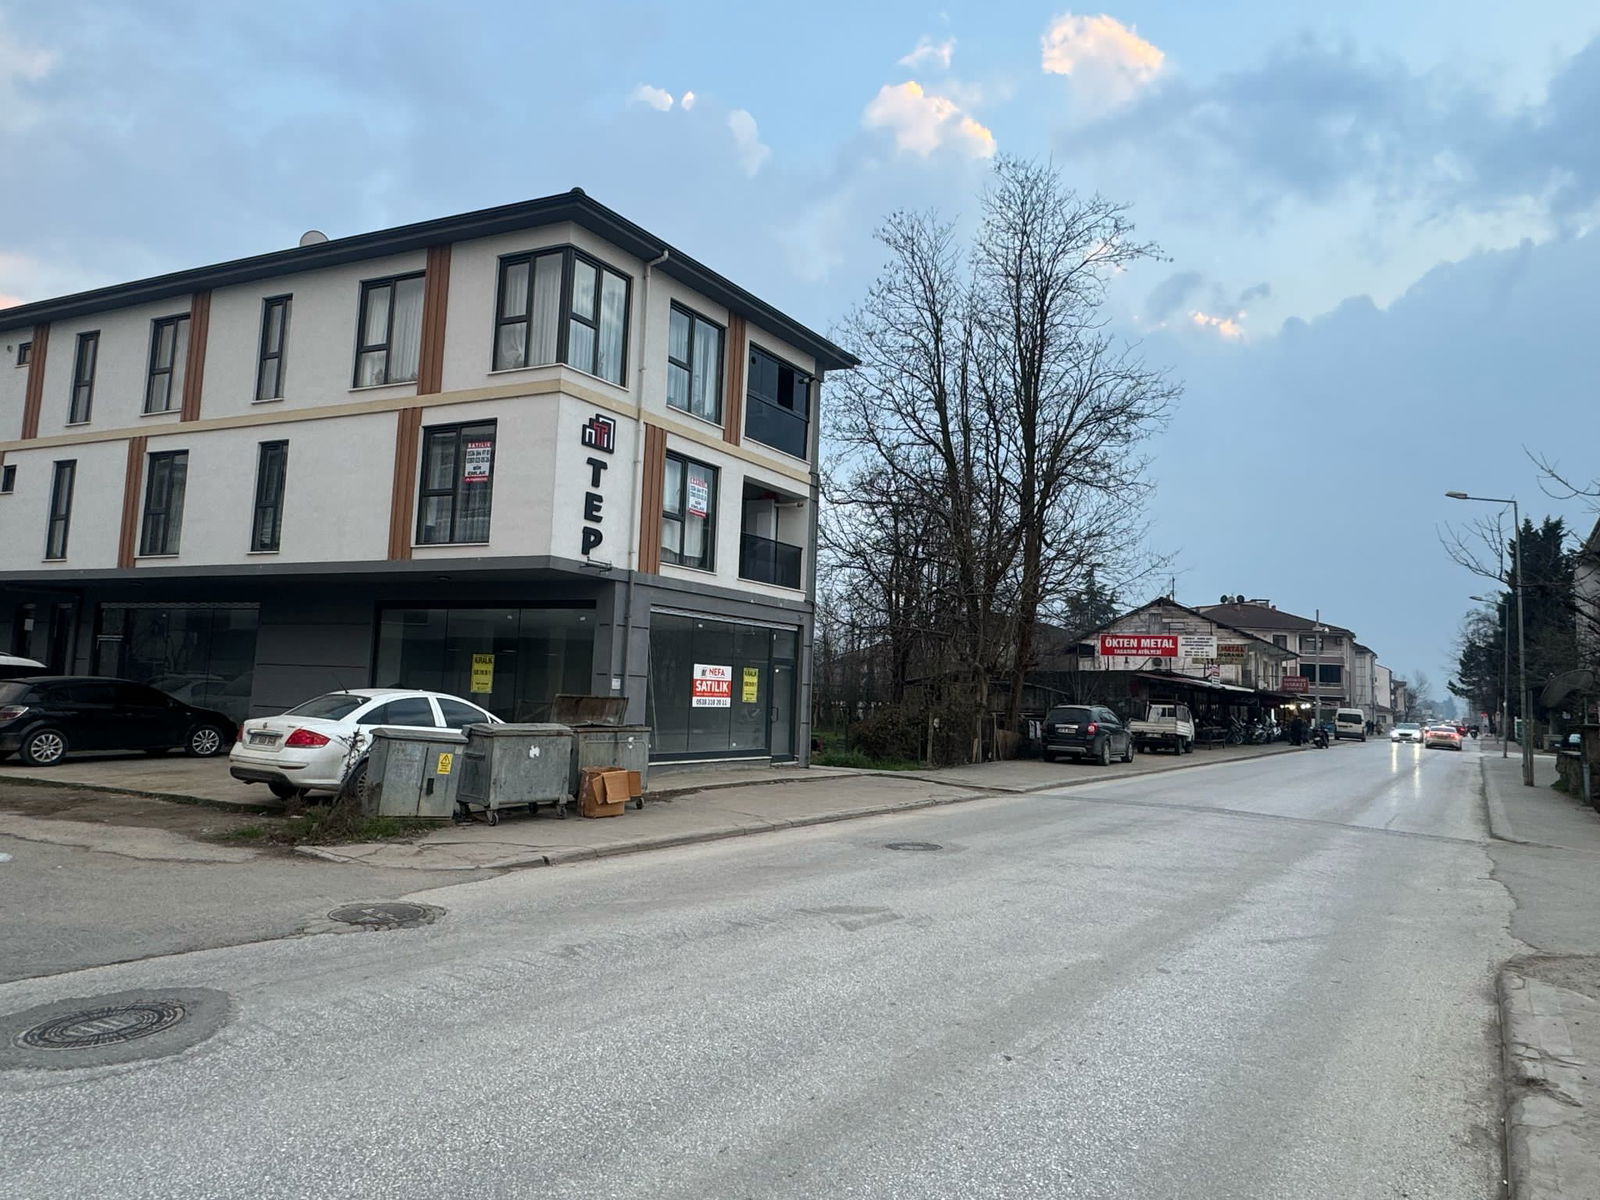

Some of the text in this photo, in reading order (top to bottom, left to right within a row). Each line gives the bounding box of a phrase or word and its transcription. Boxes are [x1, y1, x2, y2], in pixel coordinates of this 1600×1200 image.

[581, 457, 608, 556] TEP
[1105, 636, 1176, 648] ÖKTEN METAL
[709, 668, 725, 677] NEFA
[696, 680, 729, 692] SATILIK
